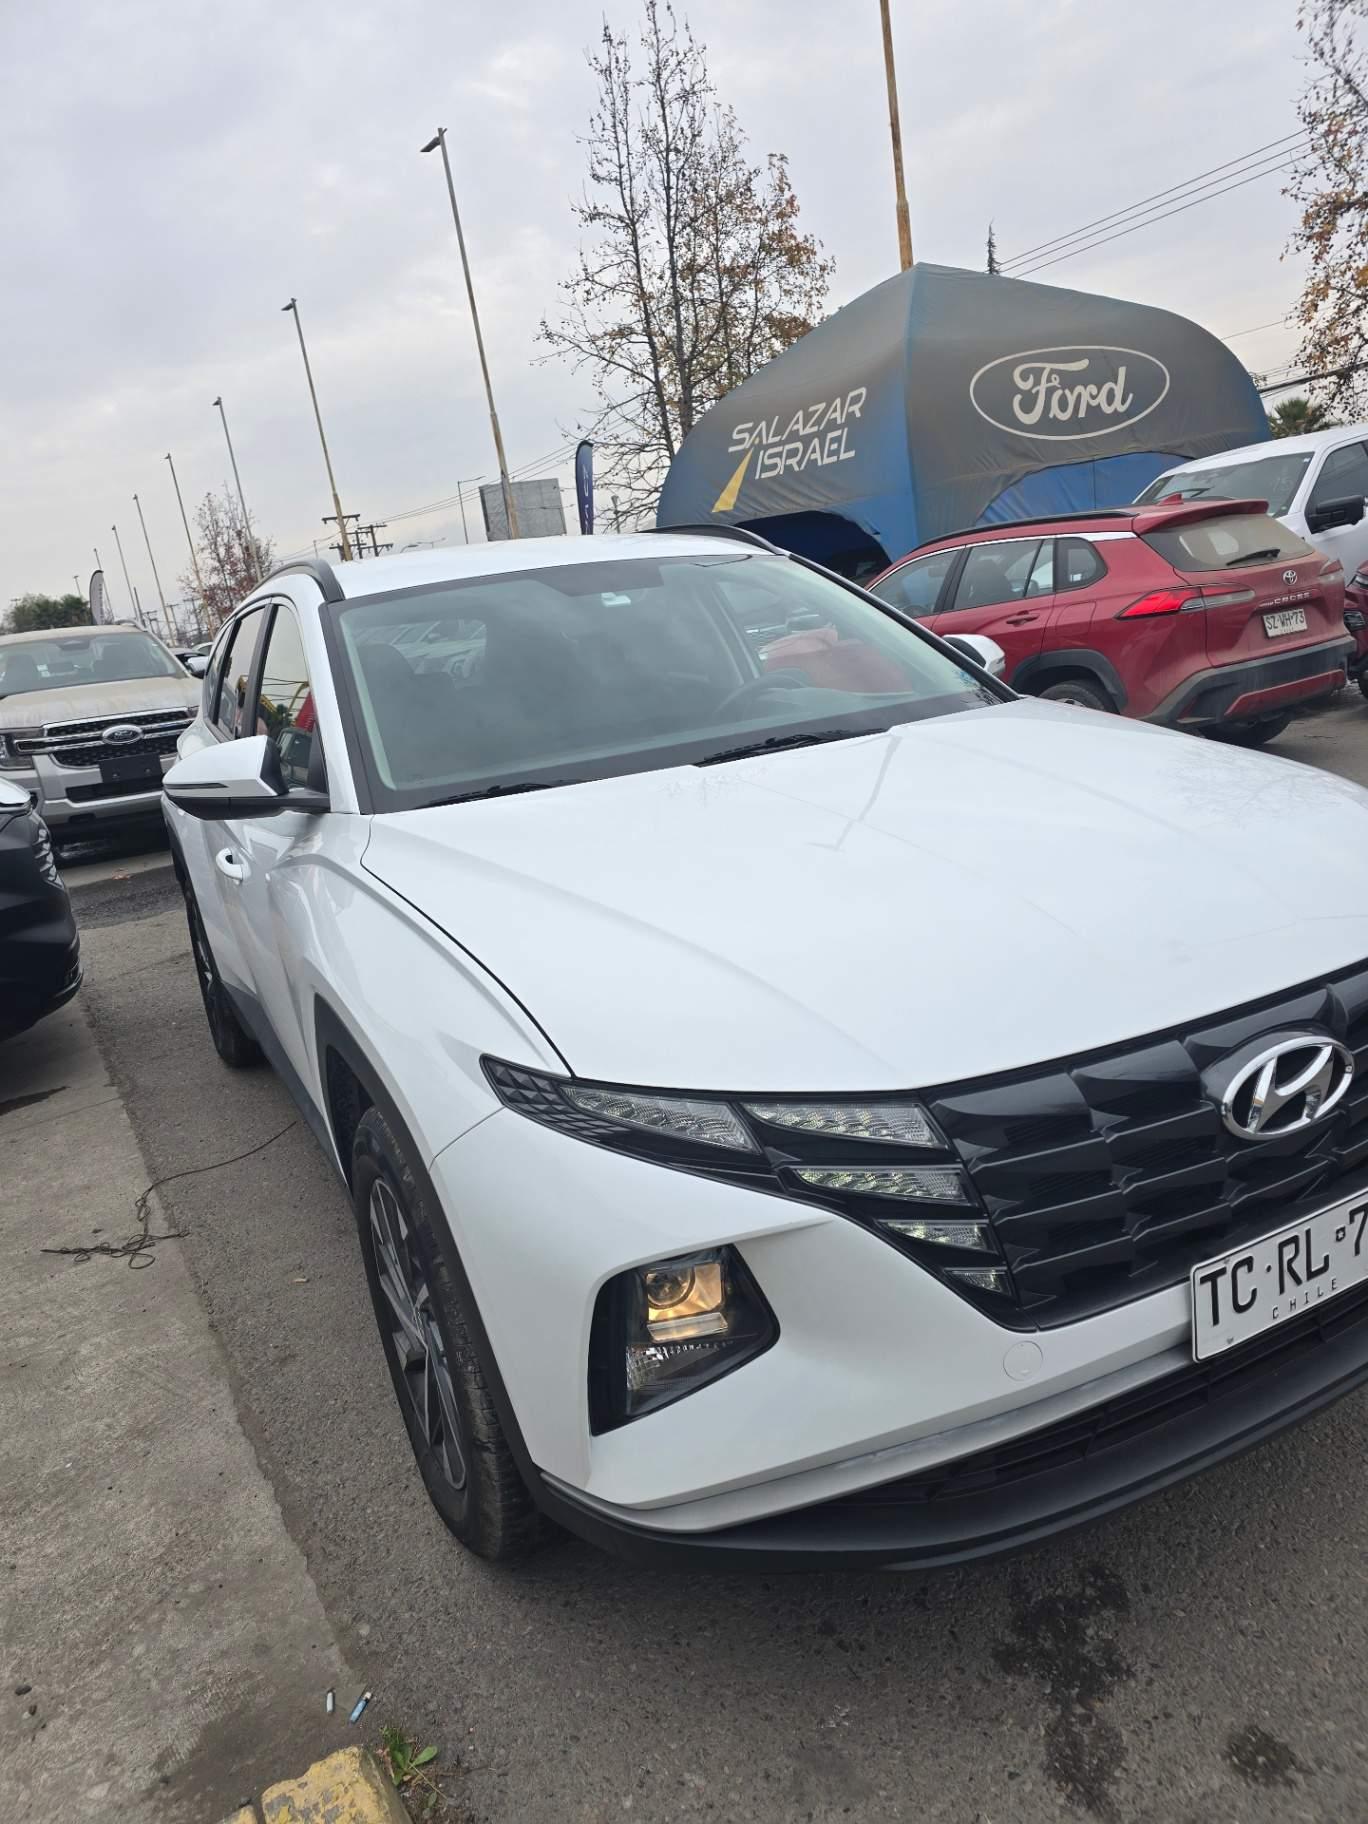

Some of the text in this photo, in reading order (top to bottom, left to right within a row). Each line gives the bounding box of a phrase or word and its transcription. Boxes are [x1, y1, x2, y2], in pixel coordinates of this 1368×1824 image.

[728, 386, 867, 453] SALAZAR
[1013, 359, 1134, 425] Ford
[754, 427, 856, 480] ISRAEL
[1272, 1278, 1338, 1320] CHILE
